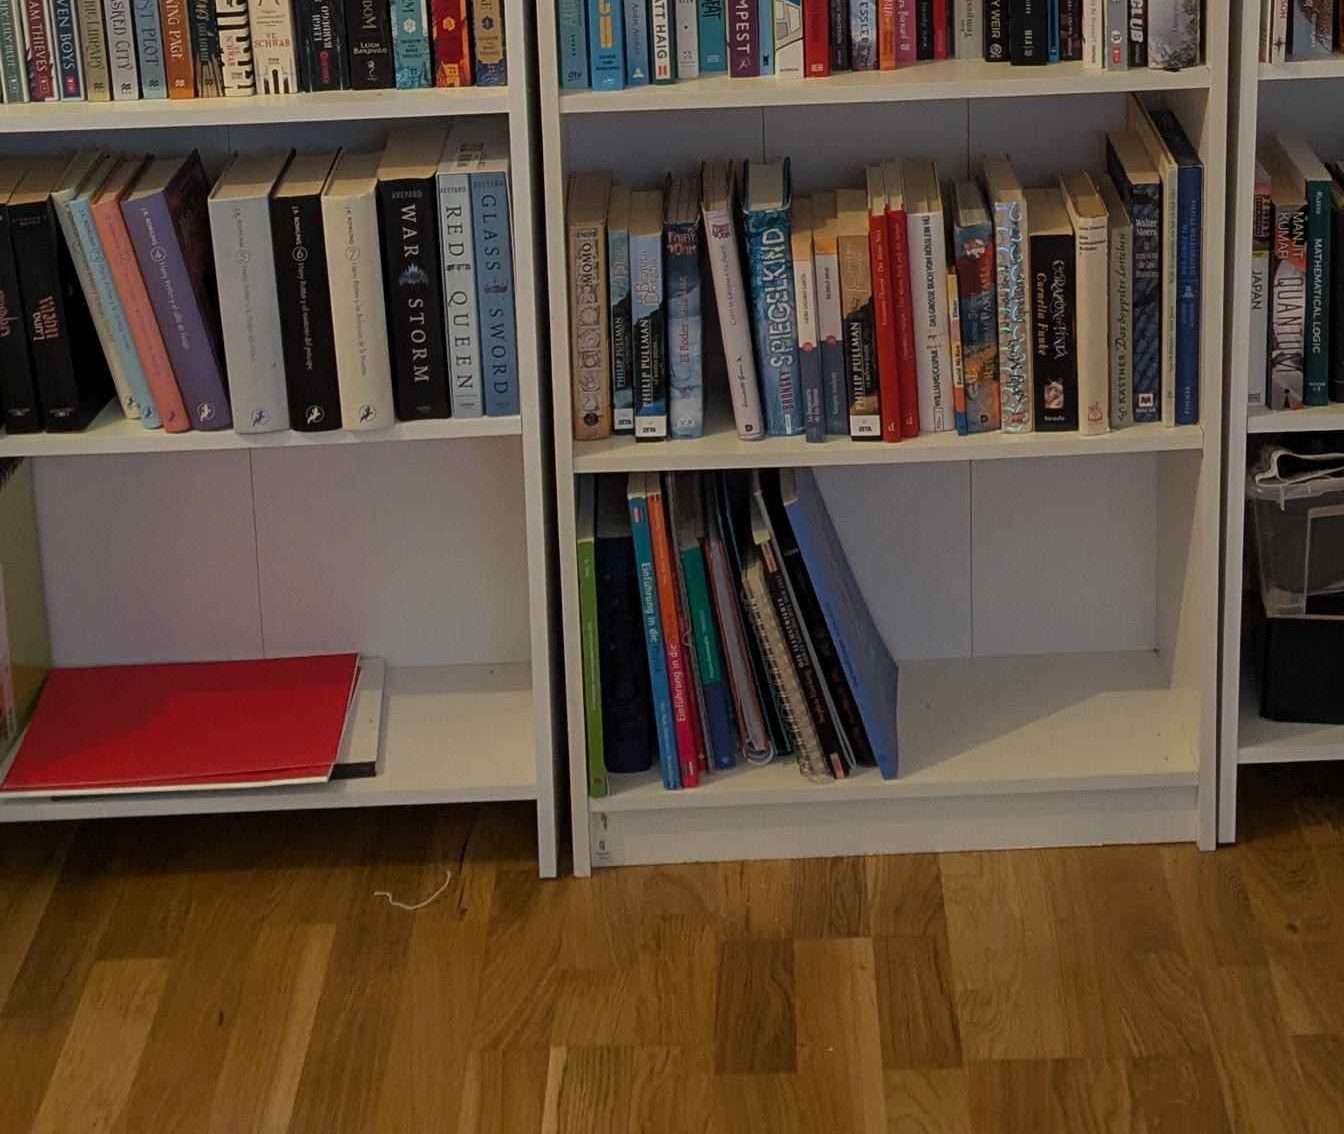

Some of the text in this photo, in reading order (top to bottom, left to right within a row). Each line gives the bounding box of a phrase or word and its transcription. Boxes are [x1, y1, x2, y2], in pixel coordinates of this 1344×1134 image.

[60, 29, 75, 70] BOYS
[656, 21, 667, 60] HAIG
[992, 2, 1000, 39] WEIR
[399, 204, 429, 382] WAR STORM
[445, 206, 473, 390] RED QUEEN
[482, 194, 508, 394] GLASS SWORD
[582, 243, 592, 287] MOMO
[1251, 271, 1263, 310] JAPAN
[1312, 239, 1323, 353] MATHEMATICAL LOGIC
[642, 319, 652, 407] PHILIP PULLMAN
[762, 228, 792, 410] BRONSKY SPIEGELKIND
[1275, 276, 1303, 371] QUANTUM
[642, 562, 658, 643] Einführung in die
